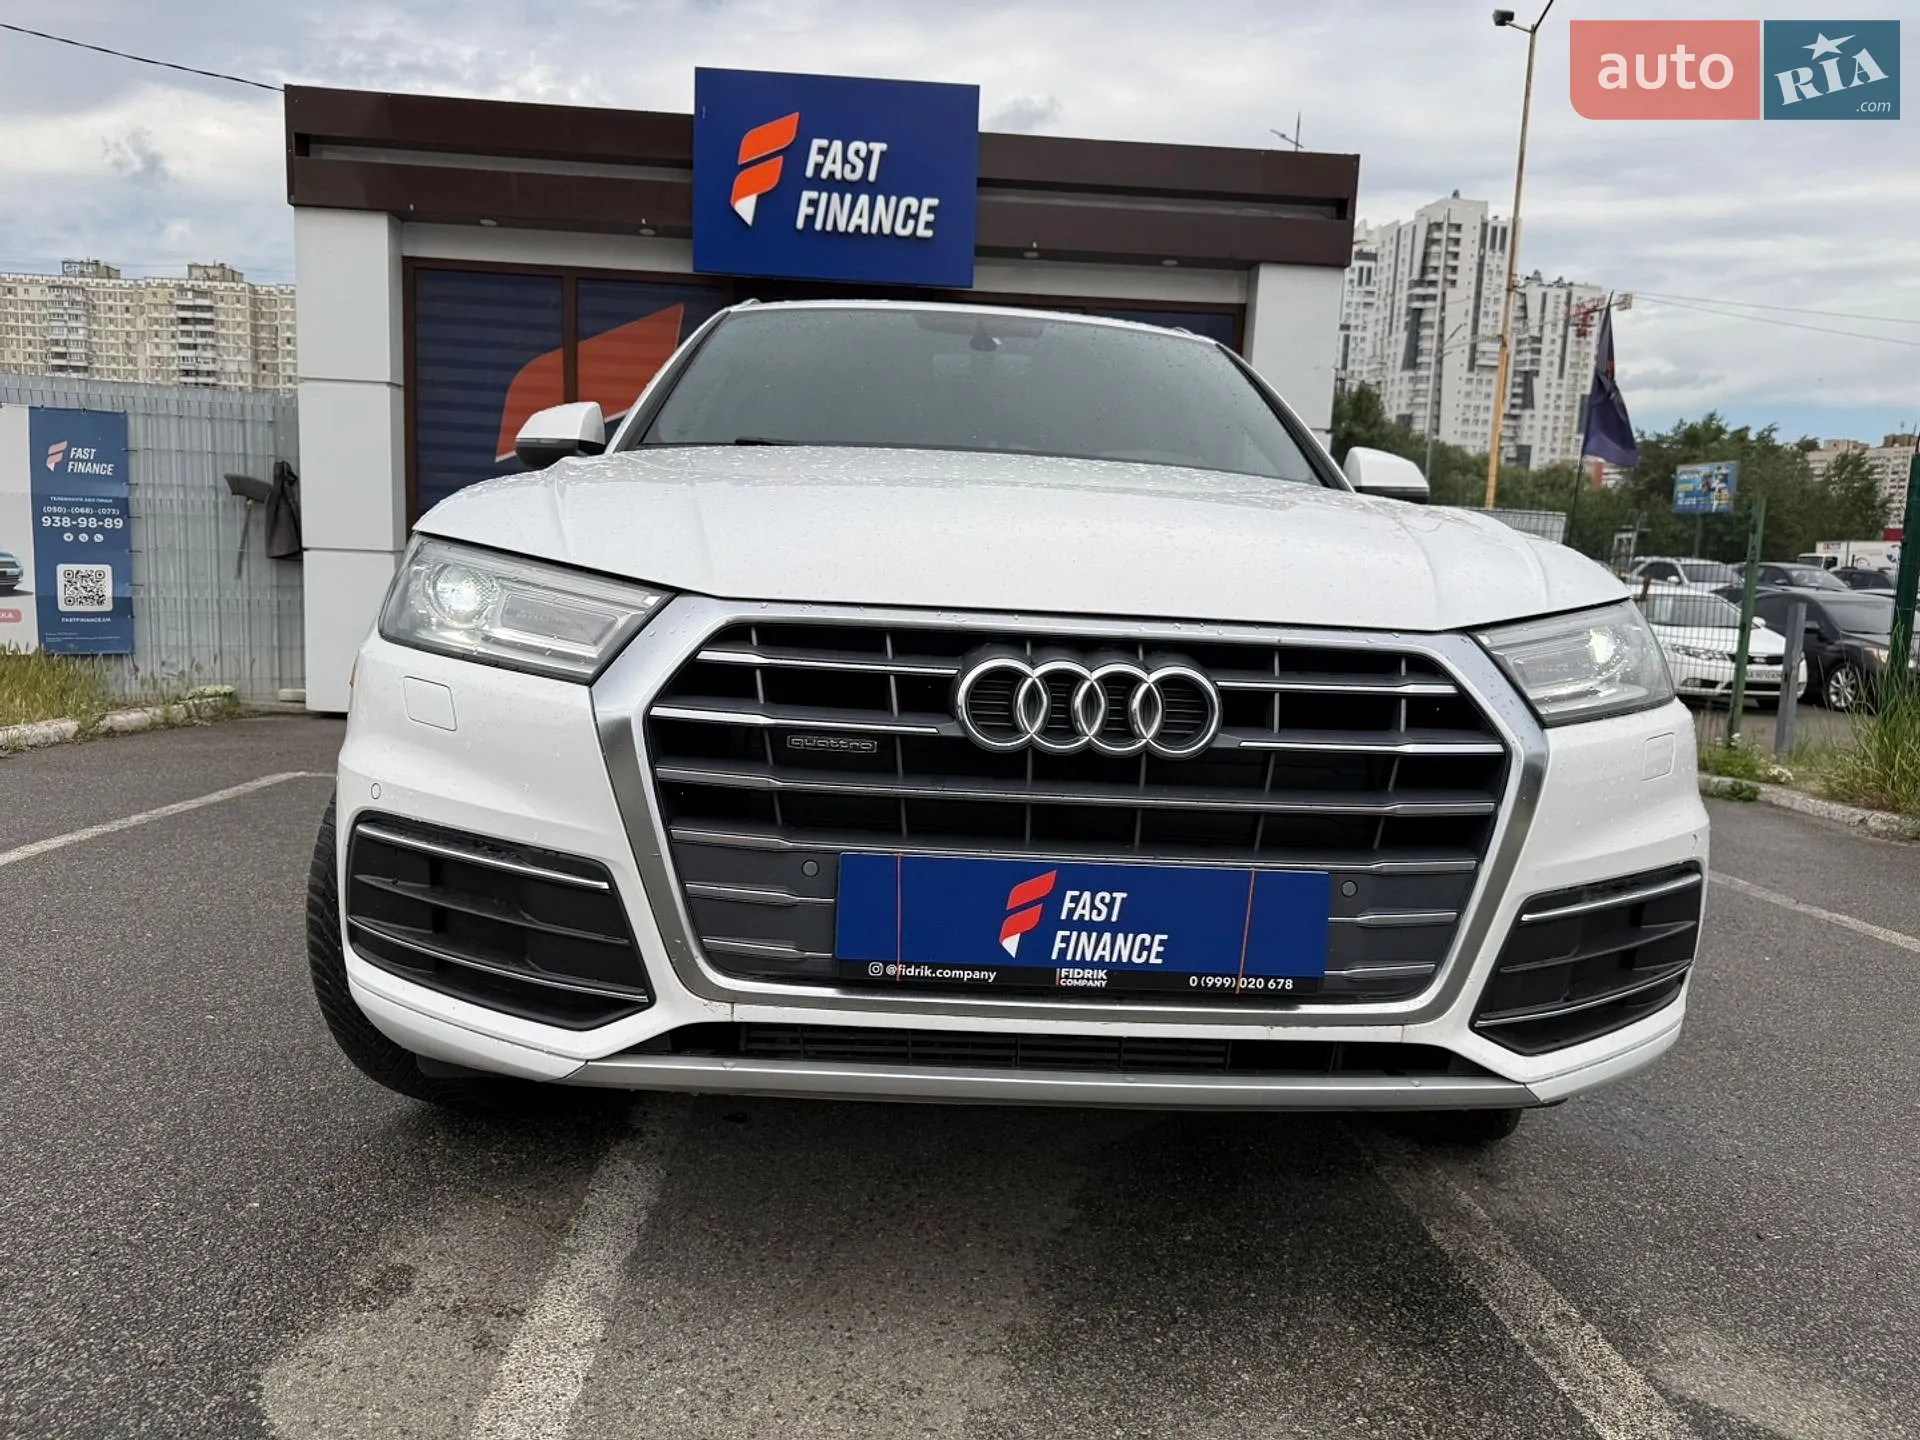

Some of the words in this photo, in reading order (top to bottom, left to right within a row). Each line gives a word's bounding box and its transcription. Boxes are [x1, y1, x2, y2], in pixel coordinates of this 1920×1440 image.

[805, 138, 888, 183] FAST
[796, 190, 940, 239] FINANCE
[70, 447, 97, 460] FAST
[67, 461, 115, 476] FINANCE
[41, 516, 124, 529] 938-98-89
[791, 738, 873, 750] quattro
[1059, 890, 1127, 922] FAST
[1051, 930, 1168, 965] FINANCE
[886, 964, 997, 982] @fidrik.company
[1061, 968, 1108, 980] FIDRIK
[1060, 978, 1107, 988] COMPANY
[1189, 977, 1198, 987] 0
[1200, 976, 1236, 989] (999)
[1240, 978, 1264, 990] 020
[1268, 979, 1294, 990] 678
